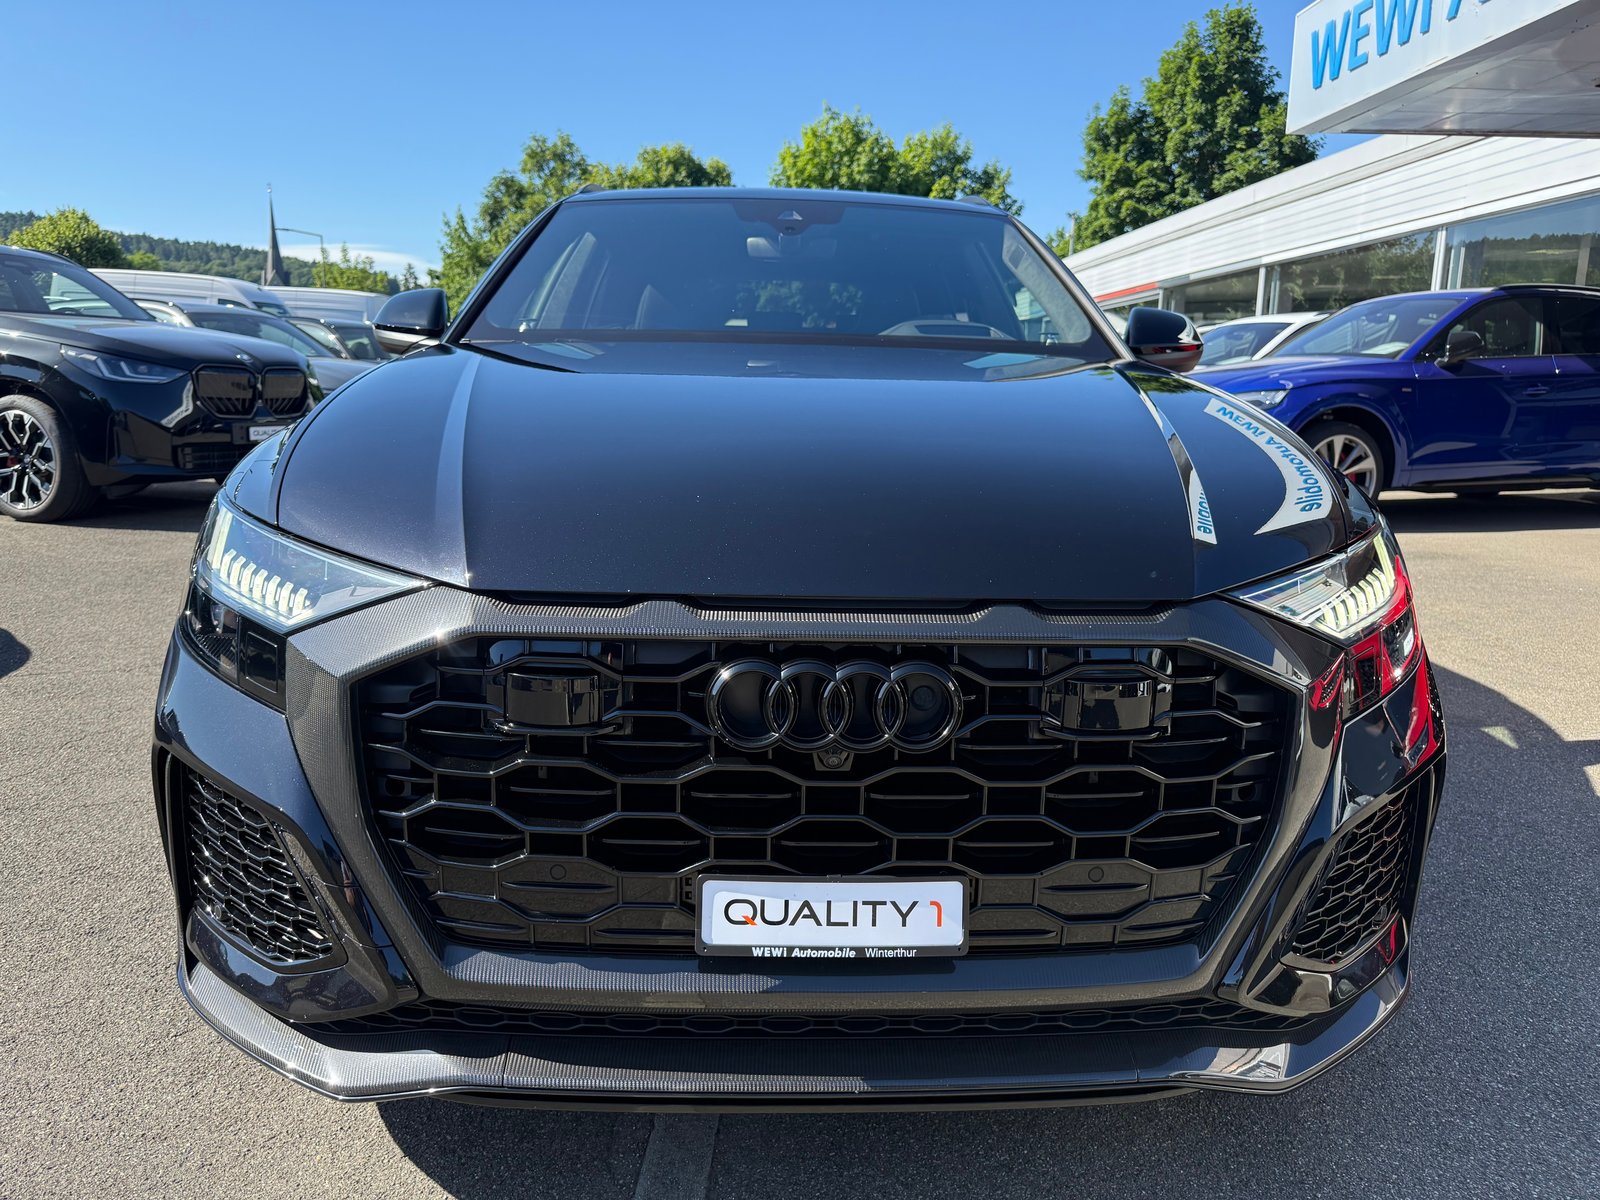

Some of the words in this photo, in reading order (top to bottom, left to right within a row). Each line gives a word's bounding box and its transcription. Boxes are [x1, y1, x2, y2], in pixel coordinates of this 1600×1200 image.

[723, 898, 919, 928] QUALITY
[929, 900, 943, 928] 1
[791, 946, 857, 959] Automobile
[865, 946, 917, 958] Winterthur
